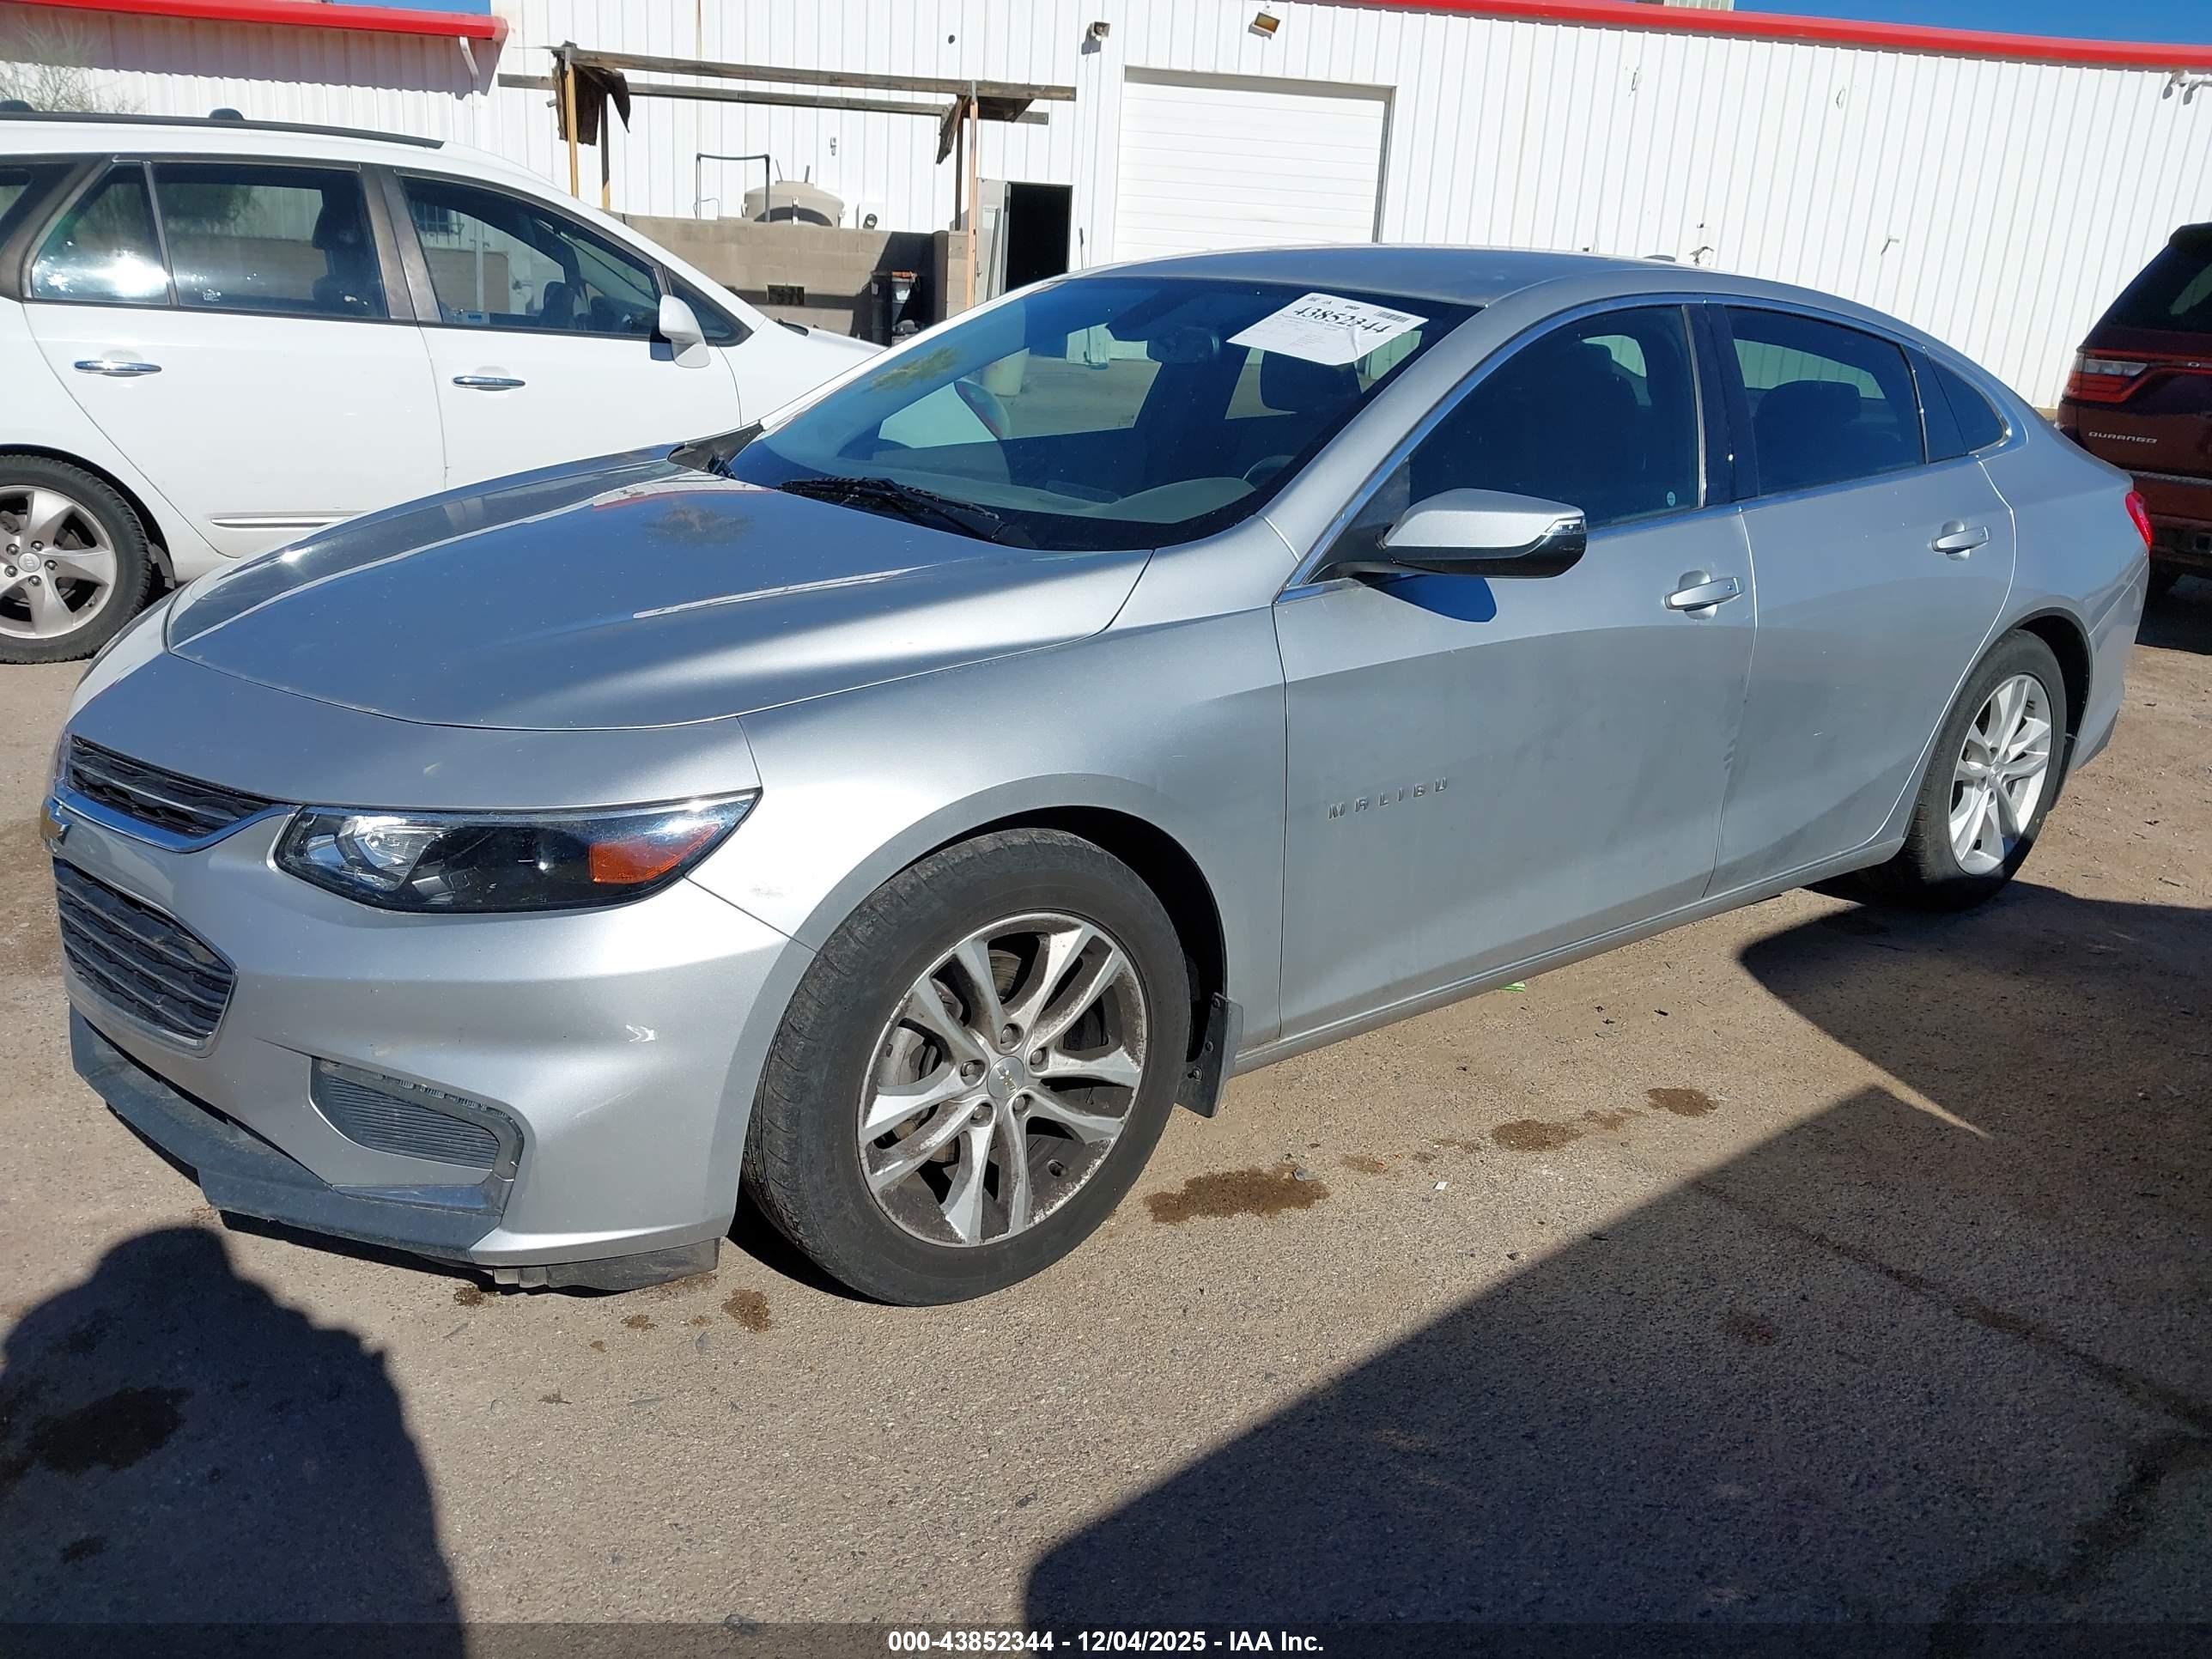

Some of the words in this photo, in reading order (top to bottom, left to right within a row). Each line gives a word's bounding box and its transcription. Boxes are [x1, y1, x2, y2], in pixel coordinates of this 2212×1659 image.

[1293, 307, 1391, 333] 43852344
[2088, 431, 2158, 444] DURANGO
[1328, 777, 1448, 819] MALIBU
